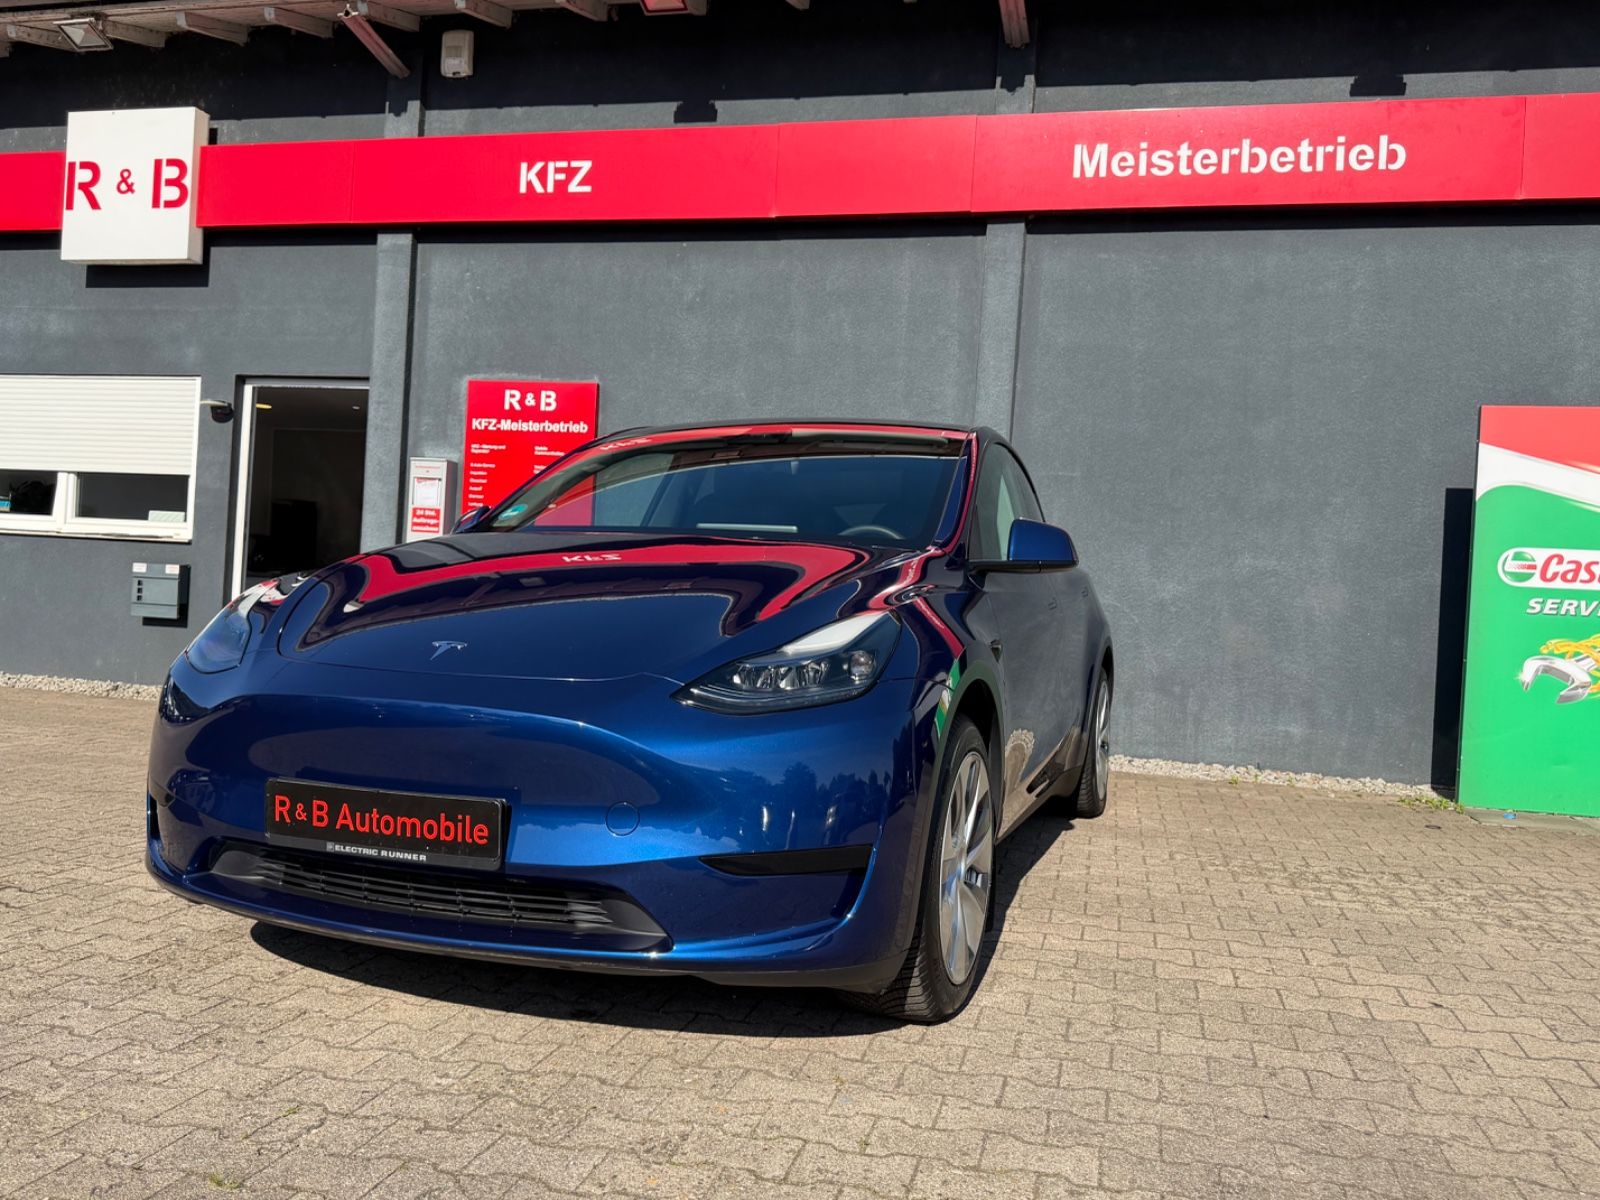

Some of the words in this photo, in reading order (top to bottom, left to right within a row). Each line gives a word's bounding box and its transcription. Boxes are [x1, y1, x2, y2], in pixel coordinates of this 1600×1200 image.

[1072, 134, 1407, 179] Meisterbetrieb
[65, 161, 102, 211] R
[116, 168, 136, 195] &
[151, 158, 190, 209] B
[519, 160, 593, 194] KFZ
[503, 389, 522, 411] R
[524, 392, 536, 407] &
[539, 390, 557, 412] B
[471, 418, 589, 434] KFZ-Meisterbetrieb
[1540, 553, 1600, 585] Cas
[274, 795, 292, 824] R
[295, 802, 308, 823] &
[312, 799, 330, 829] B
[335, 803, 490, 845] Automobile
[335, 844, 379, 856] ELECTRIC
[380, 850, 427, 862] RUNNER
